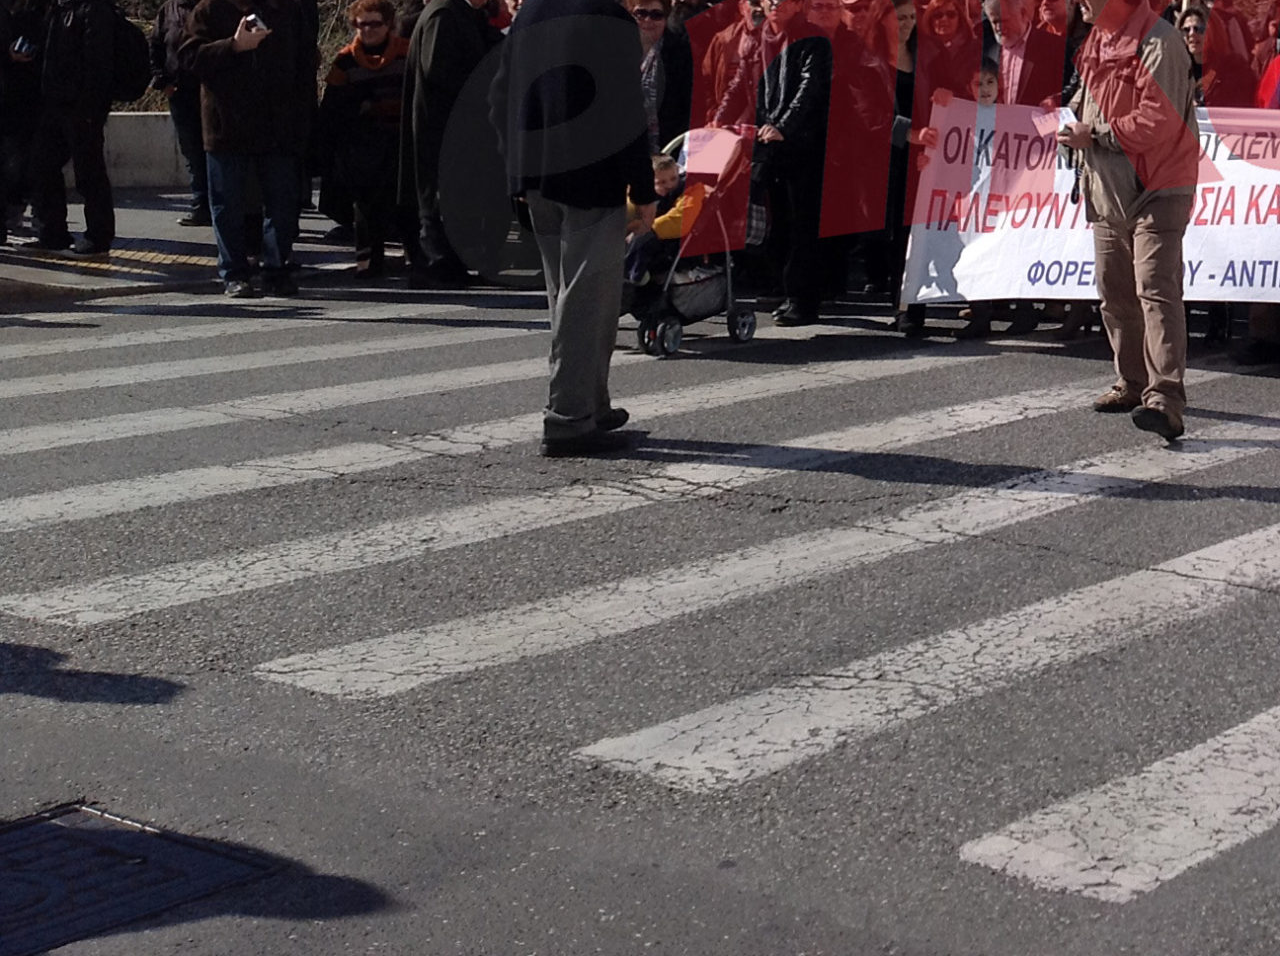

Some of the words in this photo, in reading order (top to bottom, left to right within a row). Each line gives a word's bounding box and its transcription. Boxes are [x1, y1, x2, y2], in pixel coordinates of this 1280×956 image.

[943, 126, 971, 165] ΟΙ
[925, 189, 1068, 233] ΠΑΛΕΥΟΥΝ
[1027, 260, 1096, 286] ΦΟΡΕ
